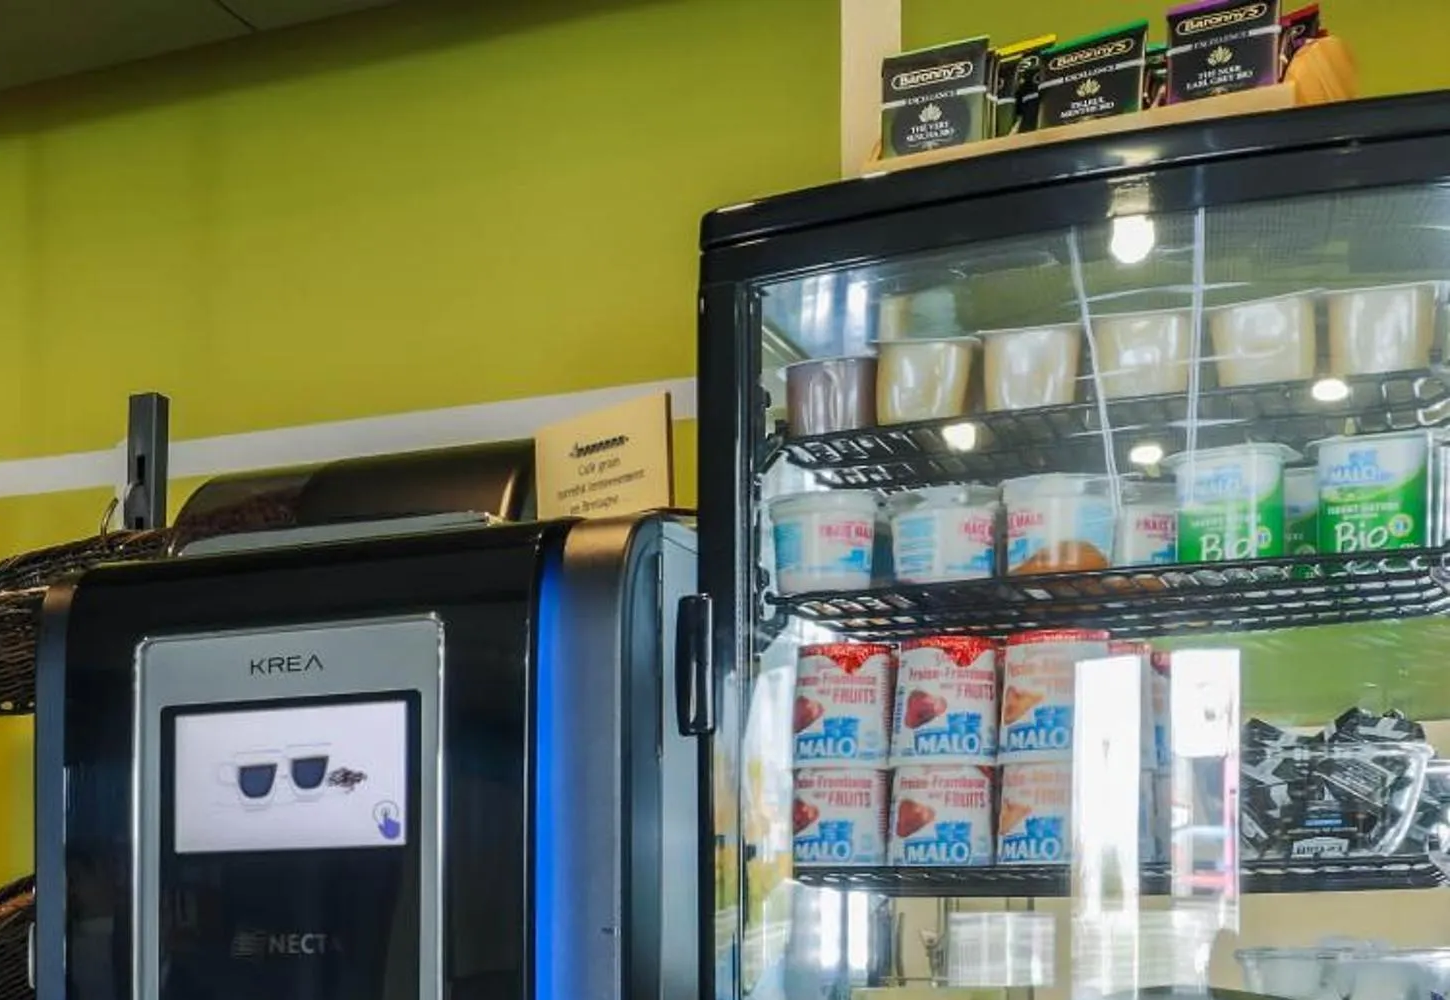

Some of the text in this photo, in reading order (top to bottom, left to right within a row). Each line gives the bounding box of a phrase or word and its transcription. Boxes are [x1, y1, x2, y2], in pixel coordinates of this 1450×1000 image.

[1334, 521, 1388, 553] Bio
[251, 654, 324, 675] KREA
[798, 736, 857, 757] MALO
[917, 732, 980, 754] MALO
[1009, 727, 1069, 750] MALO
[794, 839, 850, 861] MALO
[906, 841, 970, 863] MALO
[1003, 837, 1060, 860] MALO
[268, 932, 343, 955] NECT
